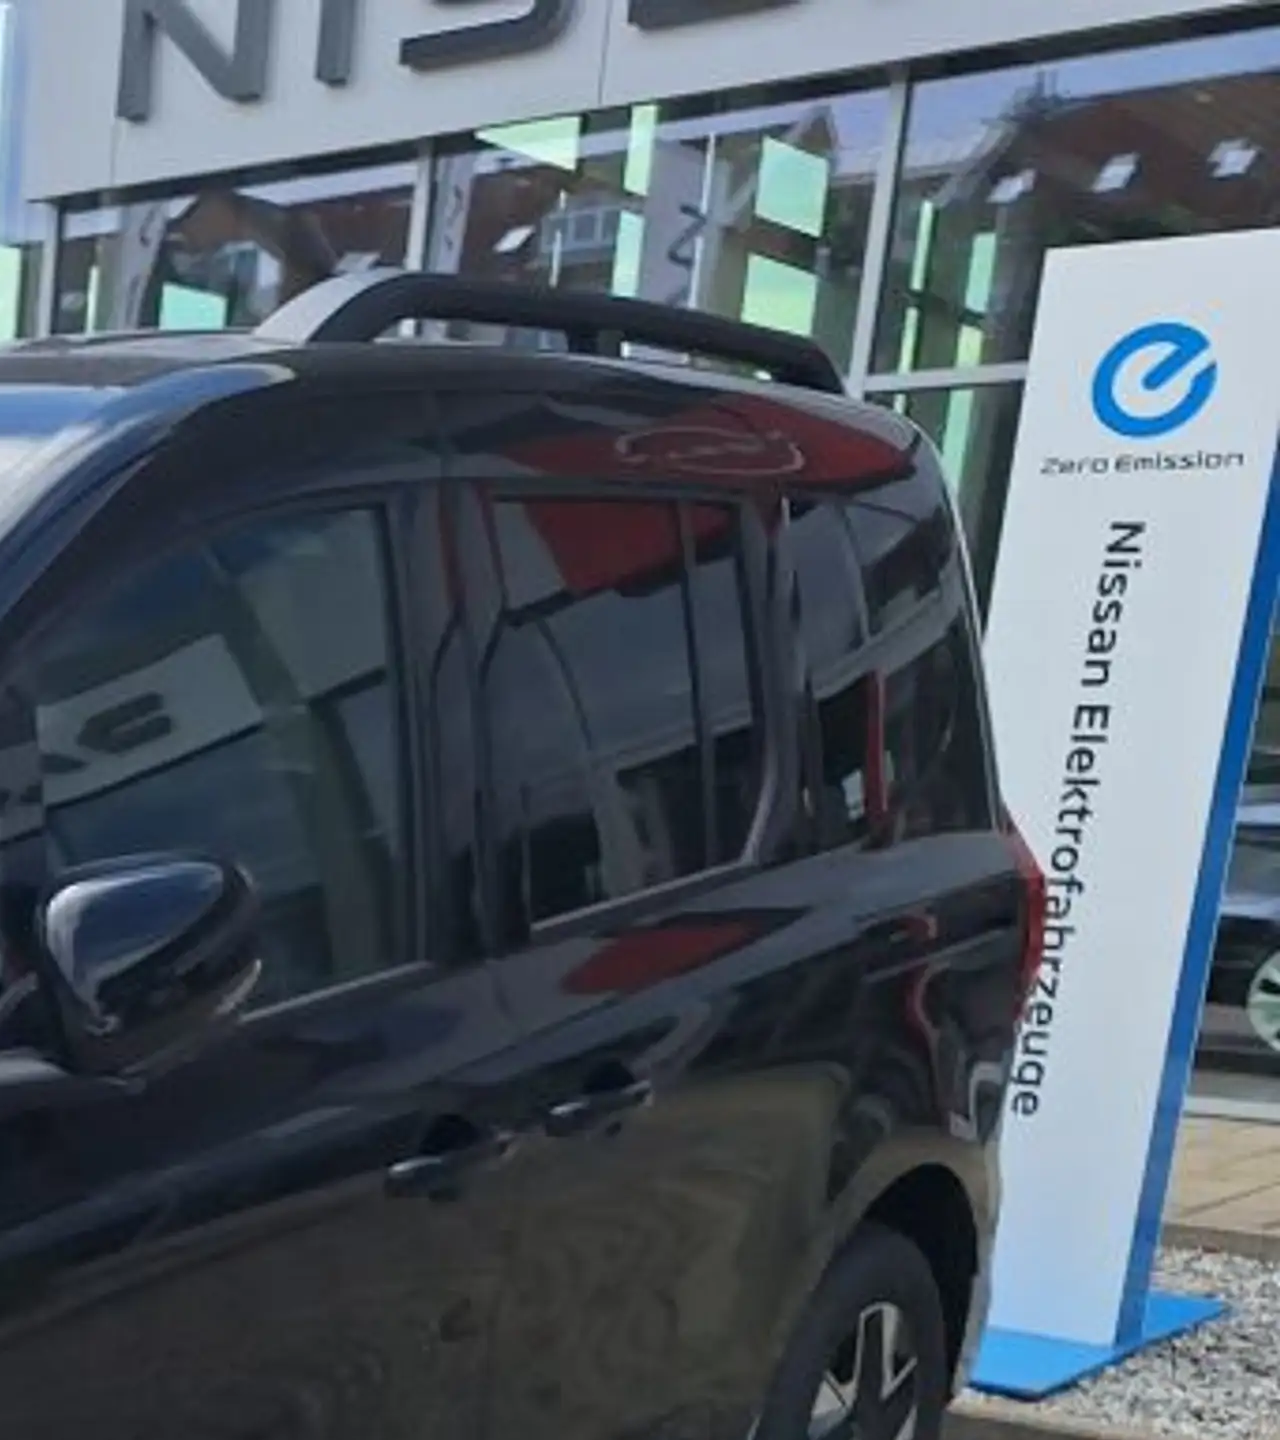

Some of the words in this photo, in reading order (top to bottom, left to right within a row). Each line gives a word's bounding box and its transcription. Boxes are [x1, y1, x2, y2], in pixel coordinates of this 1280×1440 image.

[1040, 456, 1109, 475] Zero
[1115, 450, 1245, 474] Emission
[1081, 520, 1147, 687] Nissan
[1009, 703, 1111, 1117] Elektrofahrzeuge
